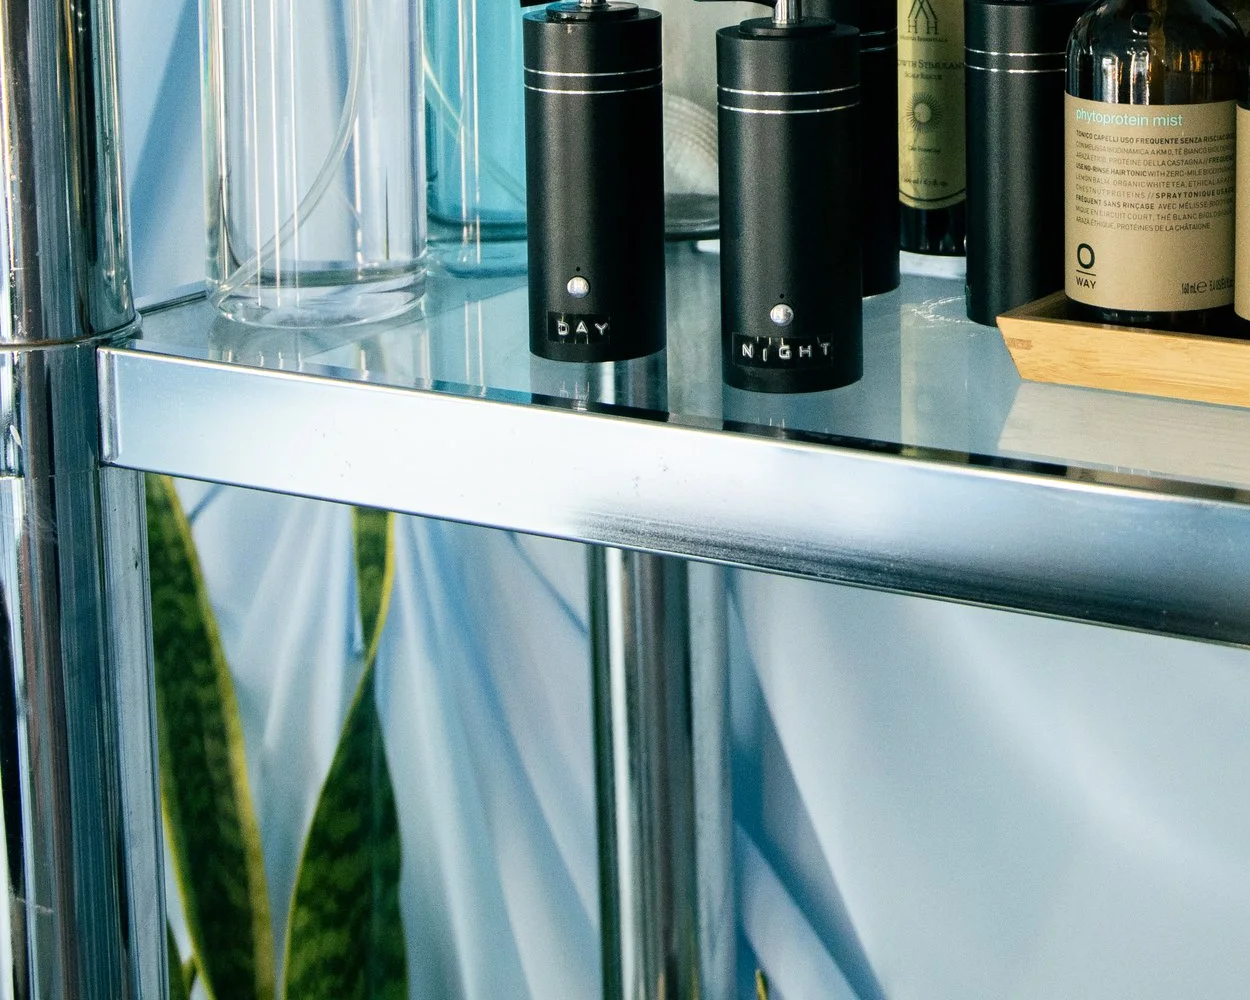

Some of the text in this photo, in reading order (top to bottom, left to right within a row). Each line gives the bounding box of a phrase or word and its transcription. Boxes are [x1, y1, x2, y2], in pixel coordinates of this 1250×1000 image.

[1076, 108, 1182, 127] phytoprotein mist
[1094, 134, 1120, 142] CAPELLI
[1180, 136, 1202, 144] SENZA
[1112, 180, 1146, 188] ORGANIC
[1156, 191, 1182, 200] SPRAY
[1183, 189, 1216, 198] TONIQUE
[1122, 202, 1154, 210] RINÇAGE
[1172, 212, 1197, 220] BLANC
[1077, 243, 1096, 270] O
[1076, 276, 1096, 290] WAY
[557, 318, 608, 336] DAY
[742, 342, 828, 362] NIGHT
